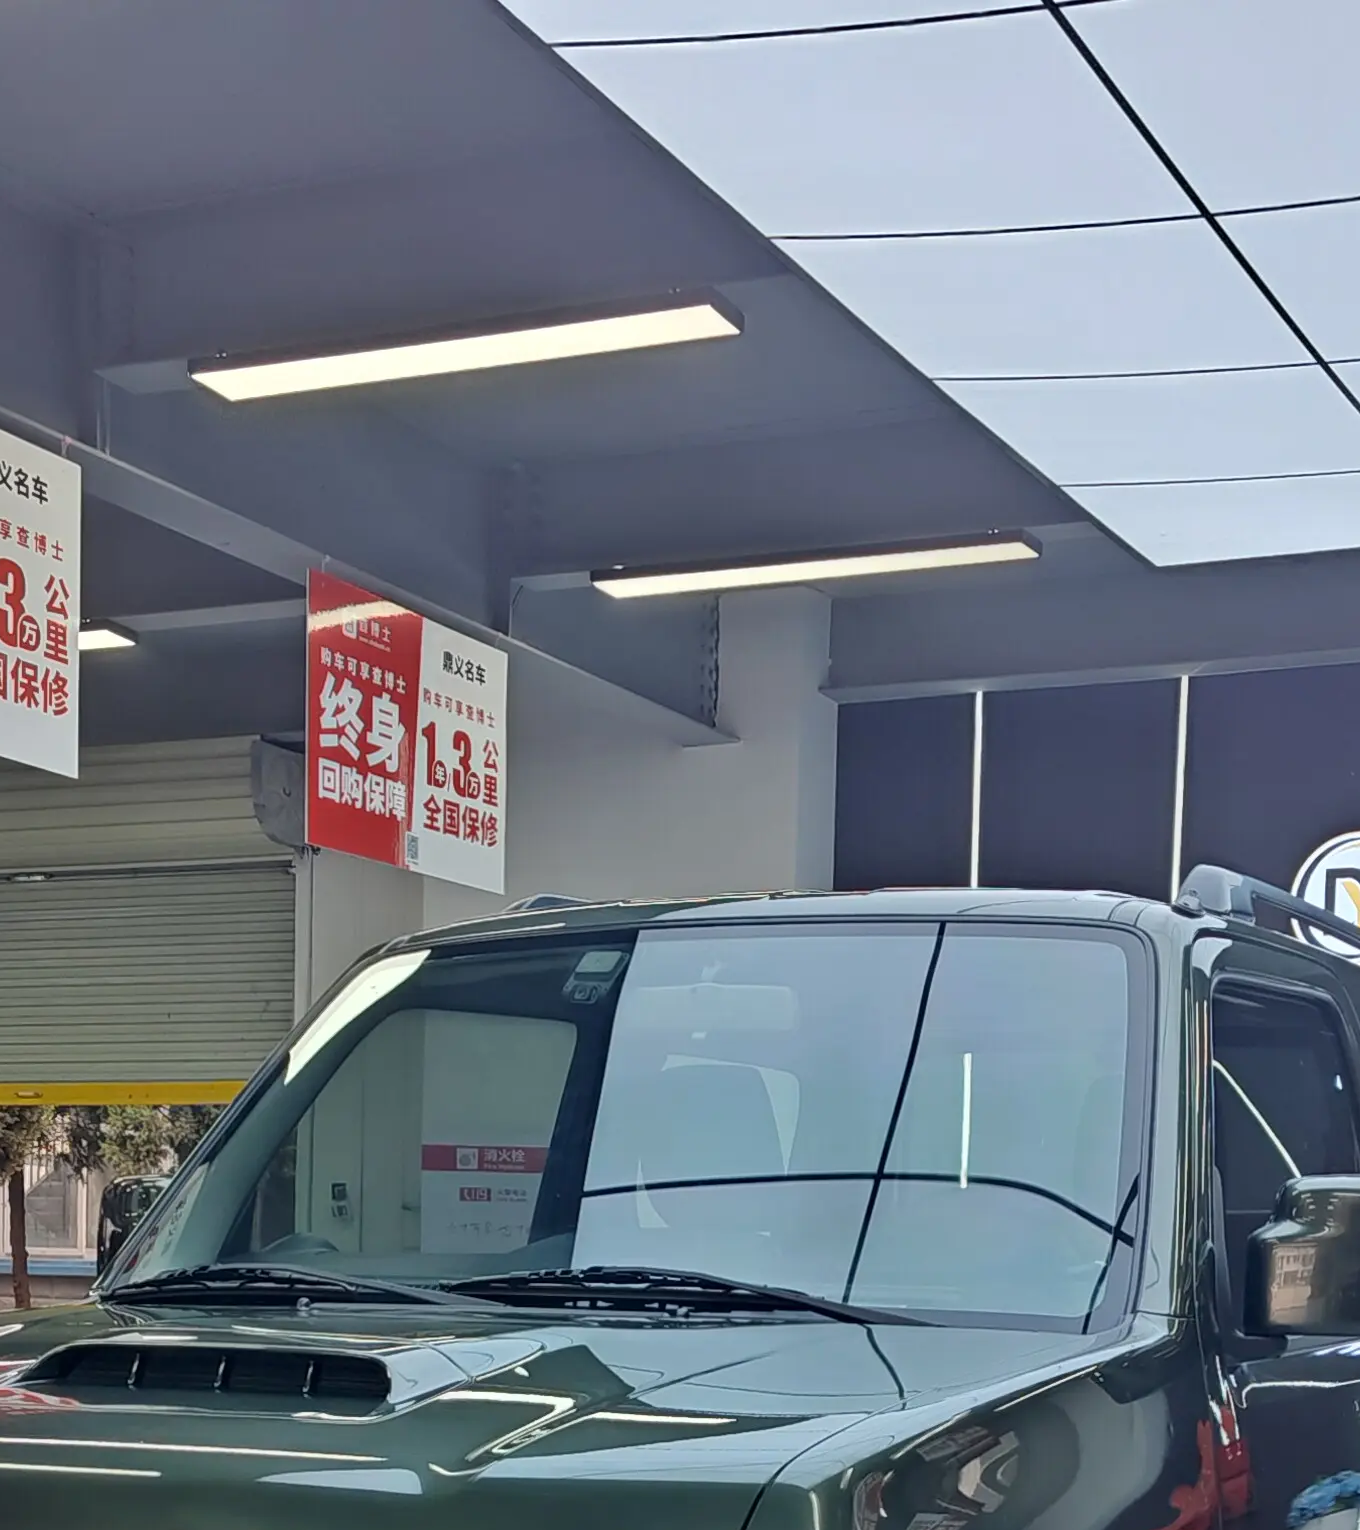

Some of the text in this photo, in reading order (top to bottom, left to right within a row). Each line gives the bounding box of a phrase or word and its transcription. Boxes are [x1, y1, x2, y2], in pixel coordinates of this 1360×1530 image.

[320, 645, 407, 695] 购车可享查博士
[442, 650, 487, 686] 鼎义名车
[318, 671, 406, 773] 终身
[423, 687, 496, 730] 购车可享查博士
[318, 757, 407, 822] 回购保障
[423, 794, 499, 848] 全国保修
[483, 1147, 525, 1163] 消火栓
